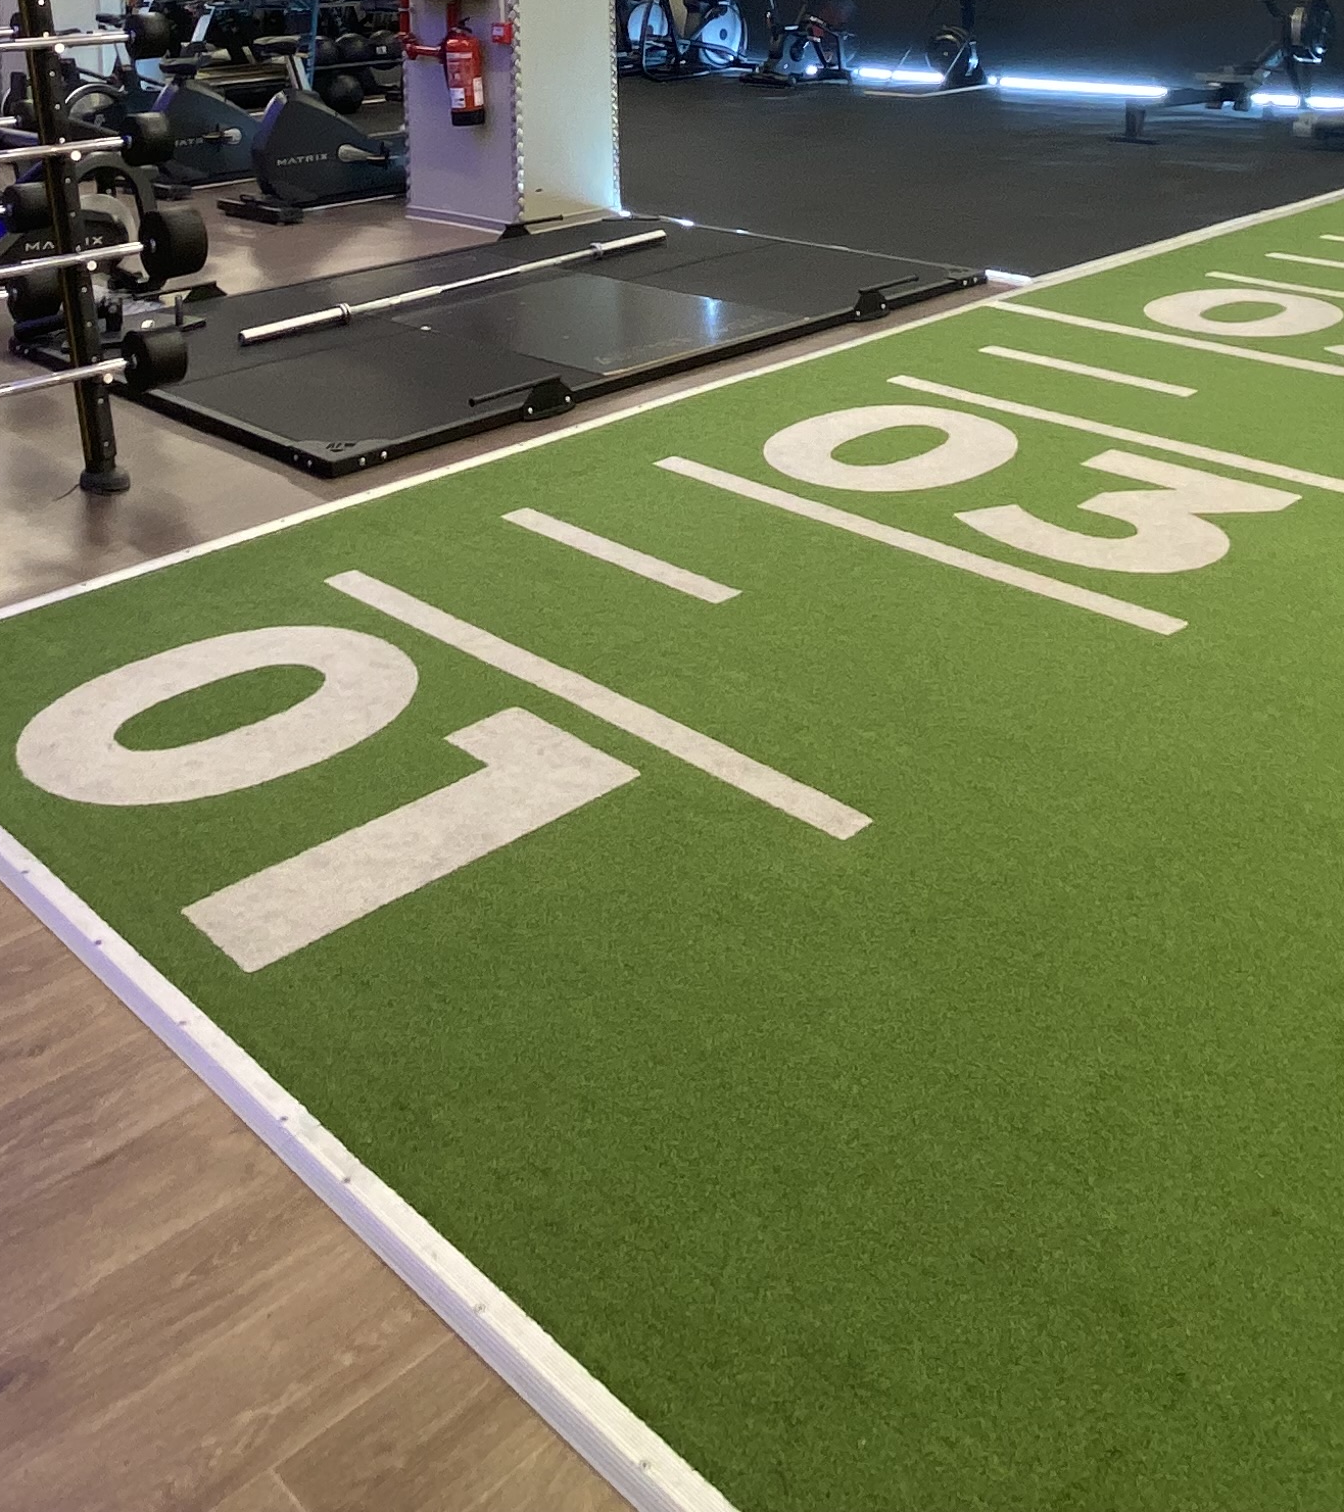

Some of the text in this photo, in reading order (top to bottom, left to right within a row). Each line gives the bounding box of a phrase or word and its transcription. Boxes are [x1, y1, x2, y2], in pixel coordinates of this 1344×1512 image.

[276, 153, 328, 167] MATRIX
[24, 236, 104, 253] MAIX
[762, 405, 1302, 574] 03
[16, 625, 641, 973] 01
